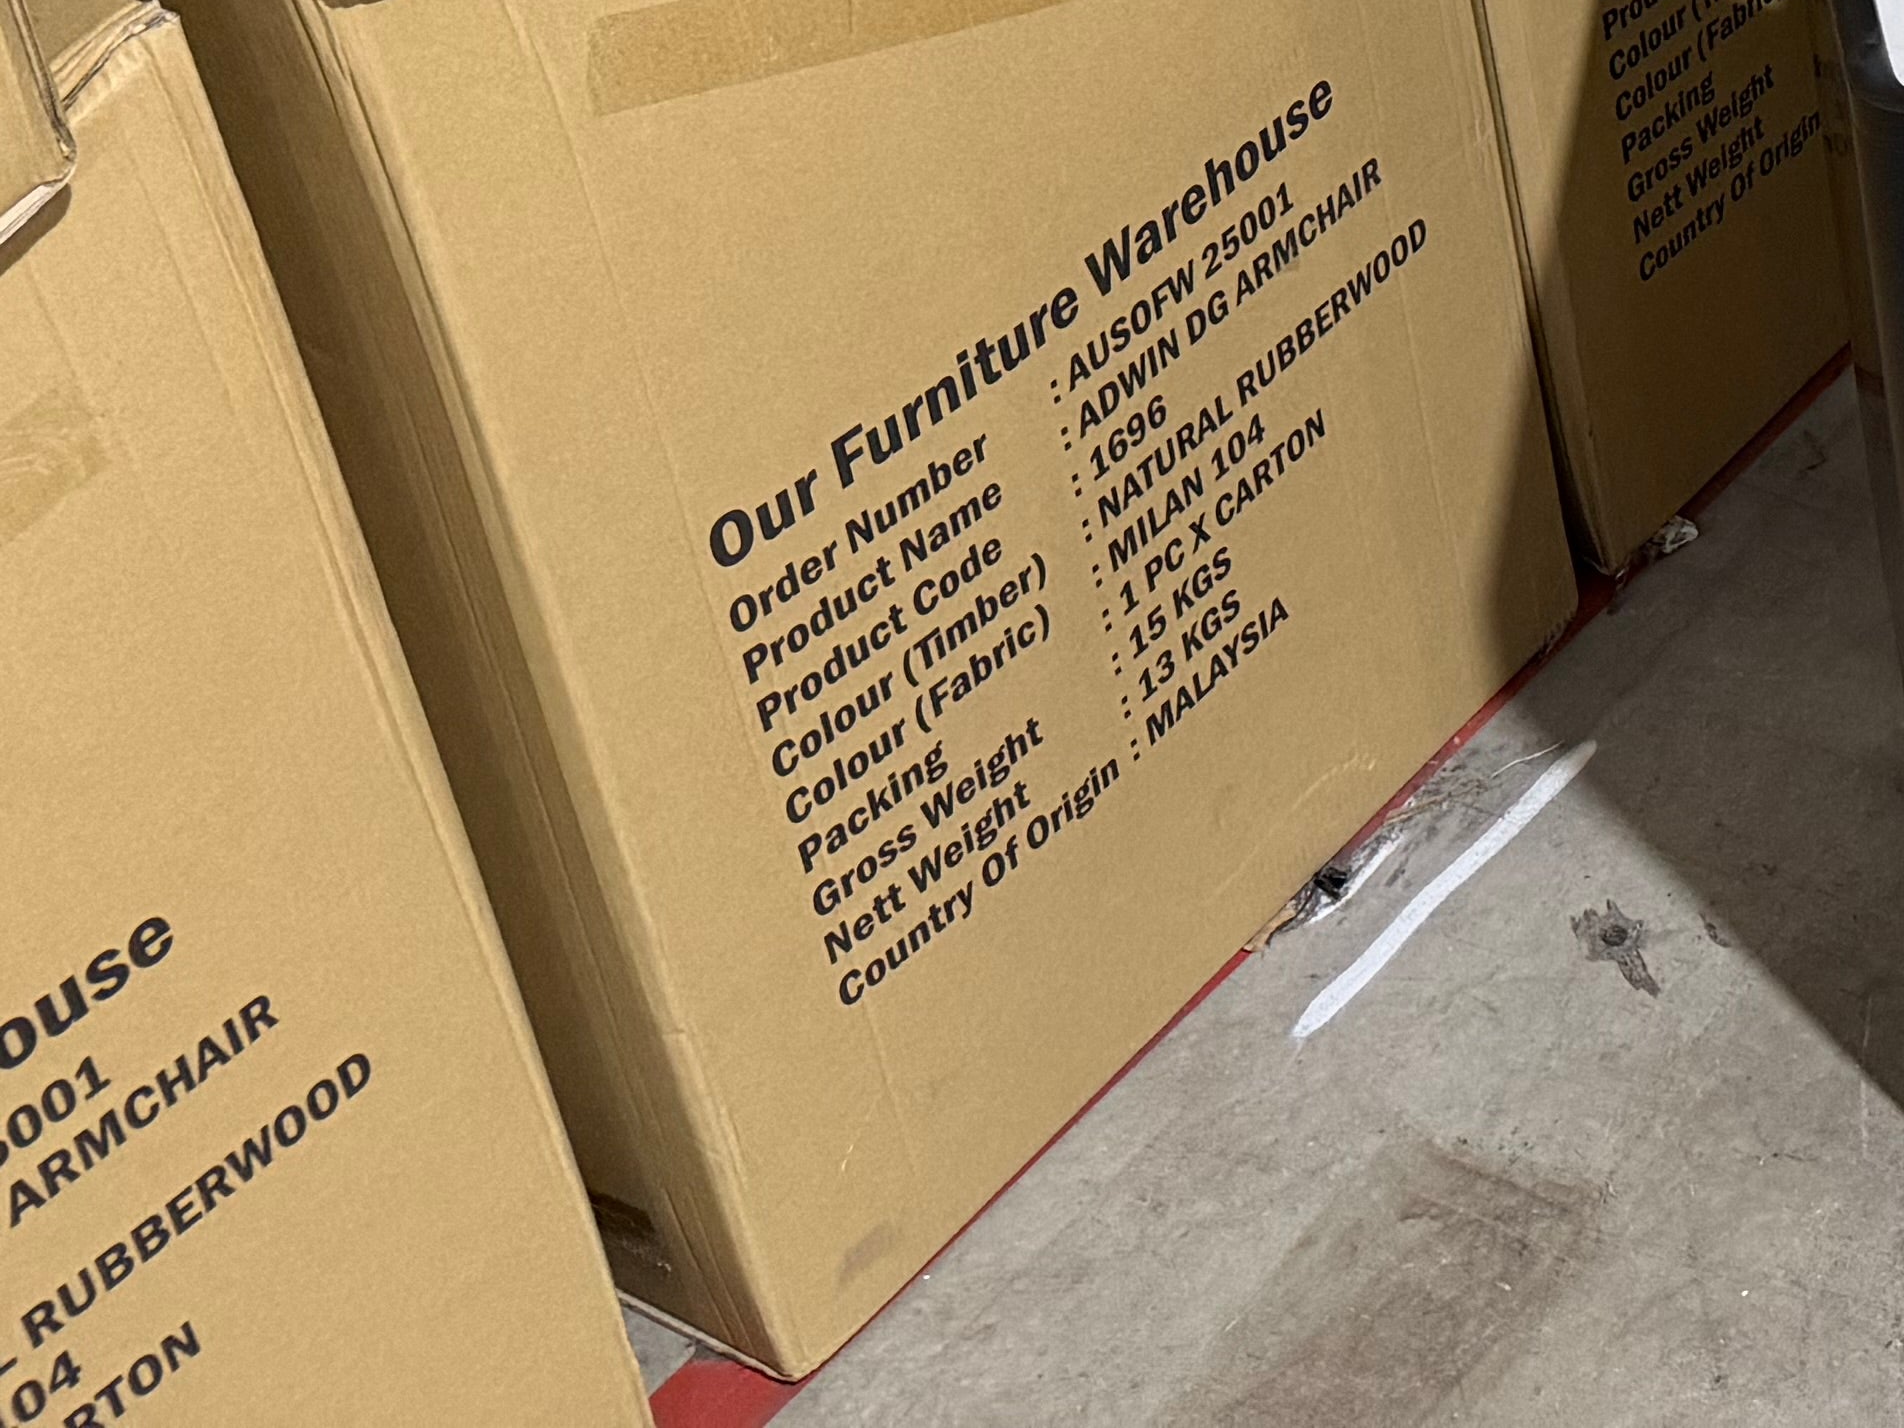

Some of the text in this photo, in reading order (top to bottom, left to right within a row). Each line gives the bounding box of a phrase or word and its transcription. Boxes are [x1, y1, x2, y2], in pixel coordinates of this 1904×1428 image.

[709, 79, 1333, 568] Our Furniture Warehouse
[1639, 110, 1823, 282] Country Of Origin
[729, 539, 838, 633] Order
[844, 433, 987, 555] Number
[1201, 181, 1295, 281] 25001
[742, 555, 897, 685] Product
[899, 482, 1002, 573] Name
[1184, 289, 1230, 346] DG
[1235, 157, 1382, 307] ARMCHAIR
[797, 739, 949, 875] Packing
[1144, 537, 1185, 593] PC
[1187, 511, 1212, 556] X
[1215, 407, 1326, 527] CARTON
[838, 879, 974, 1006] Country
[981, 834, 1019, 888] Of
[1026, 758, 1120, 850] Origin
[9, 994, 280, 1229] ARMCHAIR
[20, 1053, 372, 1350] RUBBERWOOD
